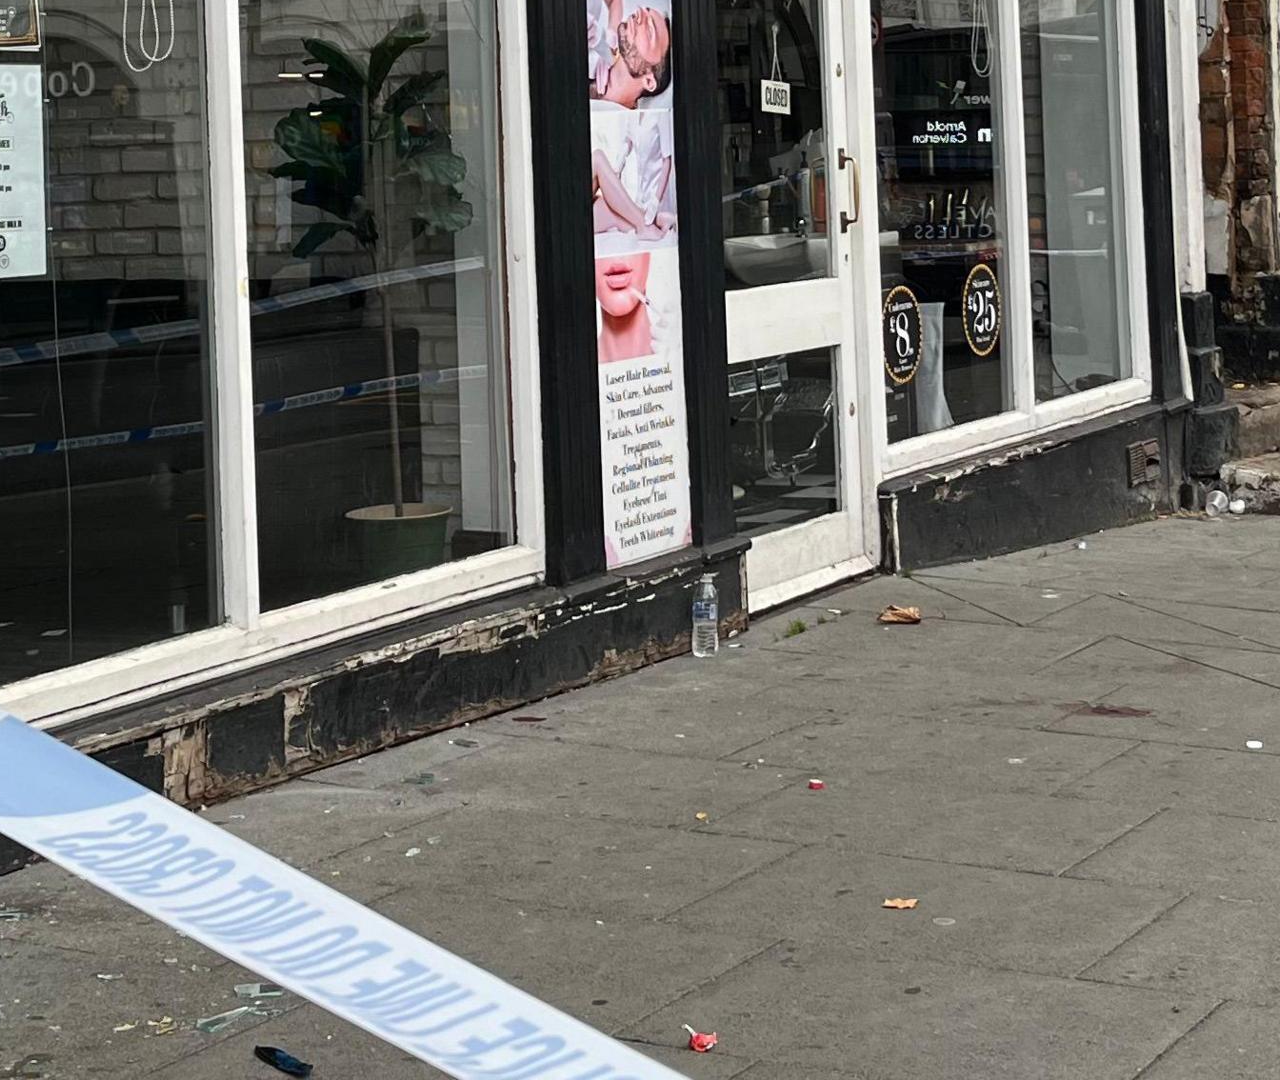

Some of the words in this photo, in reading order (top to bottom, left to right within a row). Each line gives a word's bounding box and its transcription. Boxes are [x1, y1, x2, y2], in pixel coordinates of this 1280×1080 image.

[765, 86, 787, 107] CLOSED
[606, 374, 625, 385] Laser
[626, 369, 641, 381] Hair
[642, 361, 672, 378] Removal,
[606, 391, 622, 402] Skin
[623, 389, 641, 400] Care,
[643, 380, 673, 396] Advanced
[618, 404, 642, 420] Dermal
[607, 426, 633, 440] Facials,
[635, 421, 649, 433] Anti
[650, 415, 675, 429] Wrinkle
[613, 458, 642, 476] Regional
[642, 453, 673, 468] Thinning
[612, 480, 640, 495] Cellulite
[642, 471, 675, 487] Treatment
[653, 490, 667, 501] Tint
[615, 512, 641, 532] Eyelash
[619, 534, 639, 548] Teeth
[640, 525, 674, 541] Whitening
